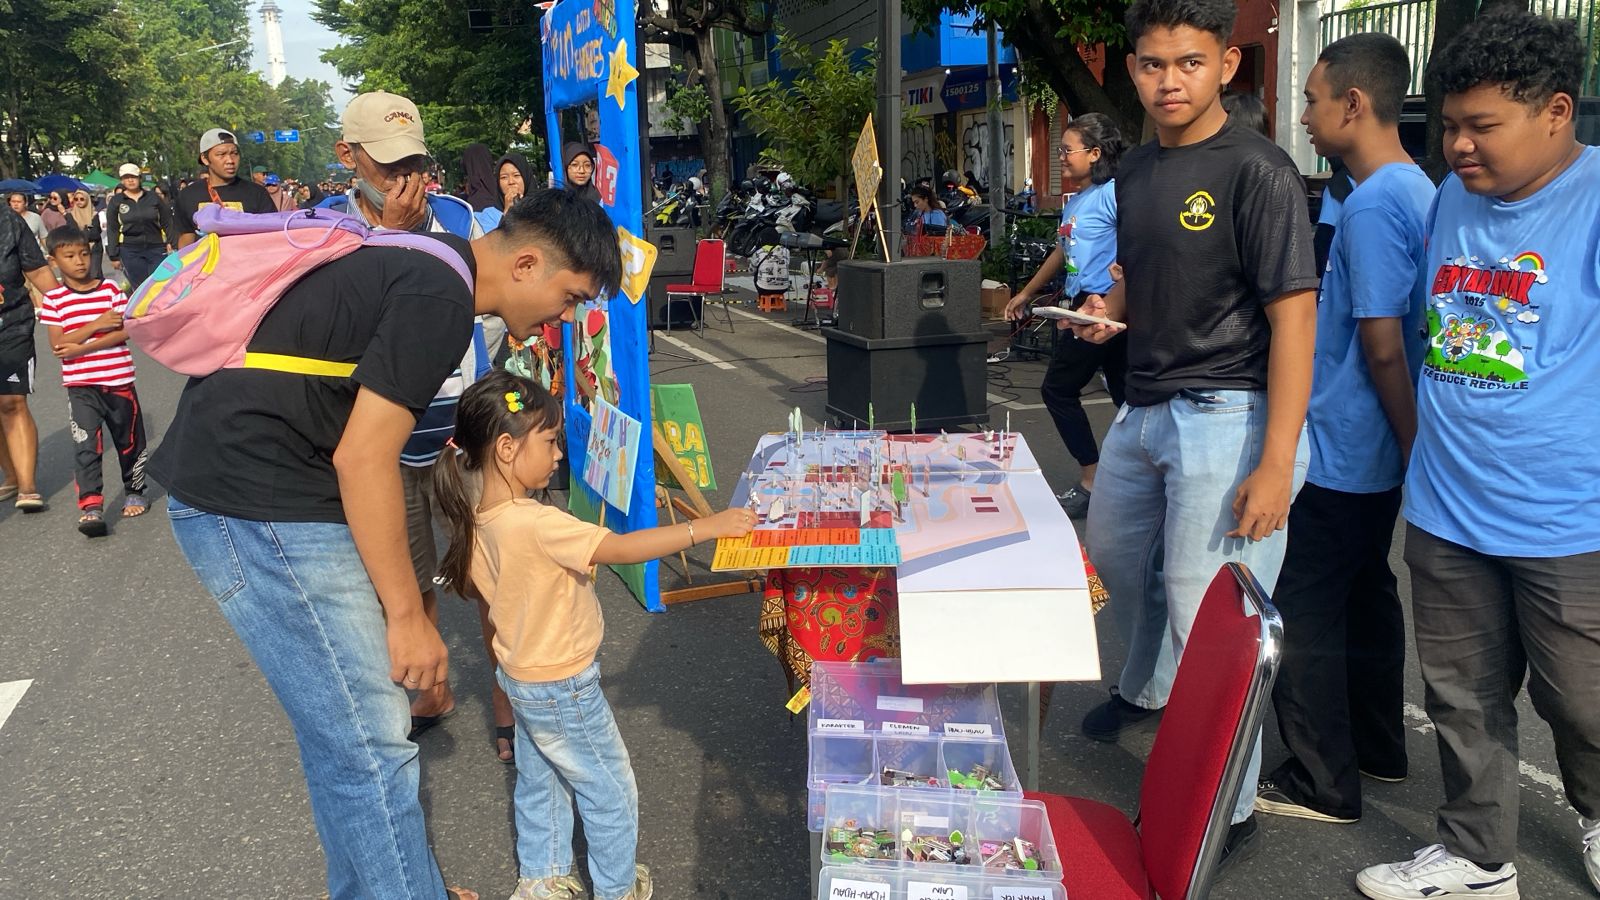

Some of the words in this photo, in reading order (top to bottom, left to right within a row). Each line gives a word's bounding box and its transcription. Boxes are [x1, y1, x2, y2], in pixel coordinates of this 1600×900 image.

[908, 86, 933, 105] TIKI
[945, 84, 979, 97] 1500125
[384, 111, 415, 123] CAMEL
[1489, 270, 1537, 306] ANAK
[1464, 295, 1486, 307] 2025
